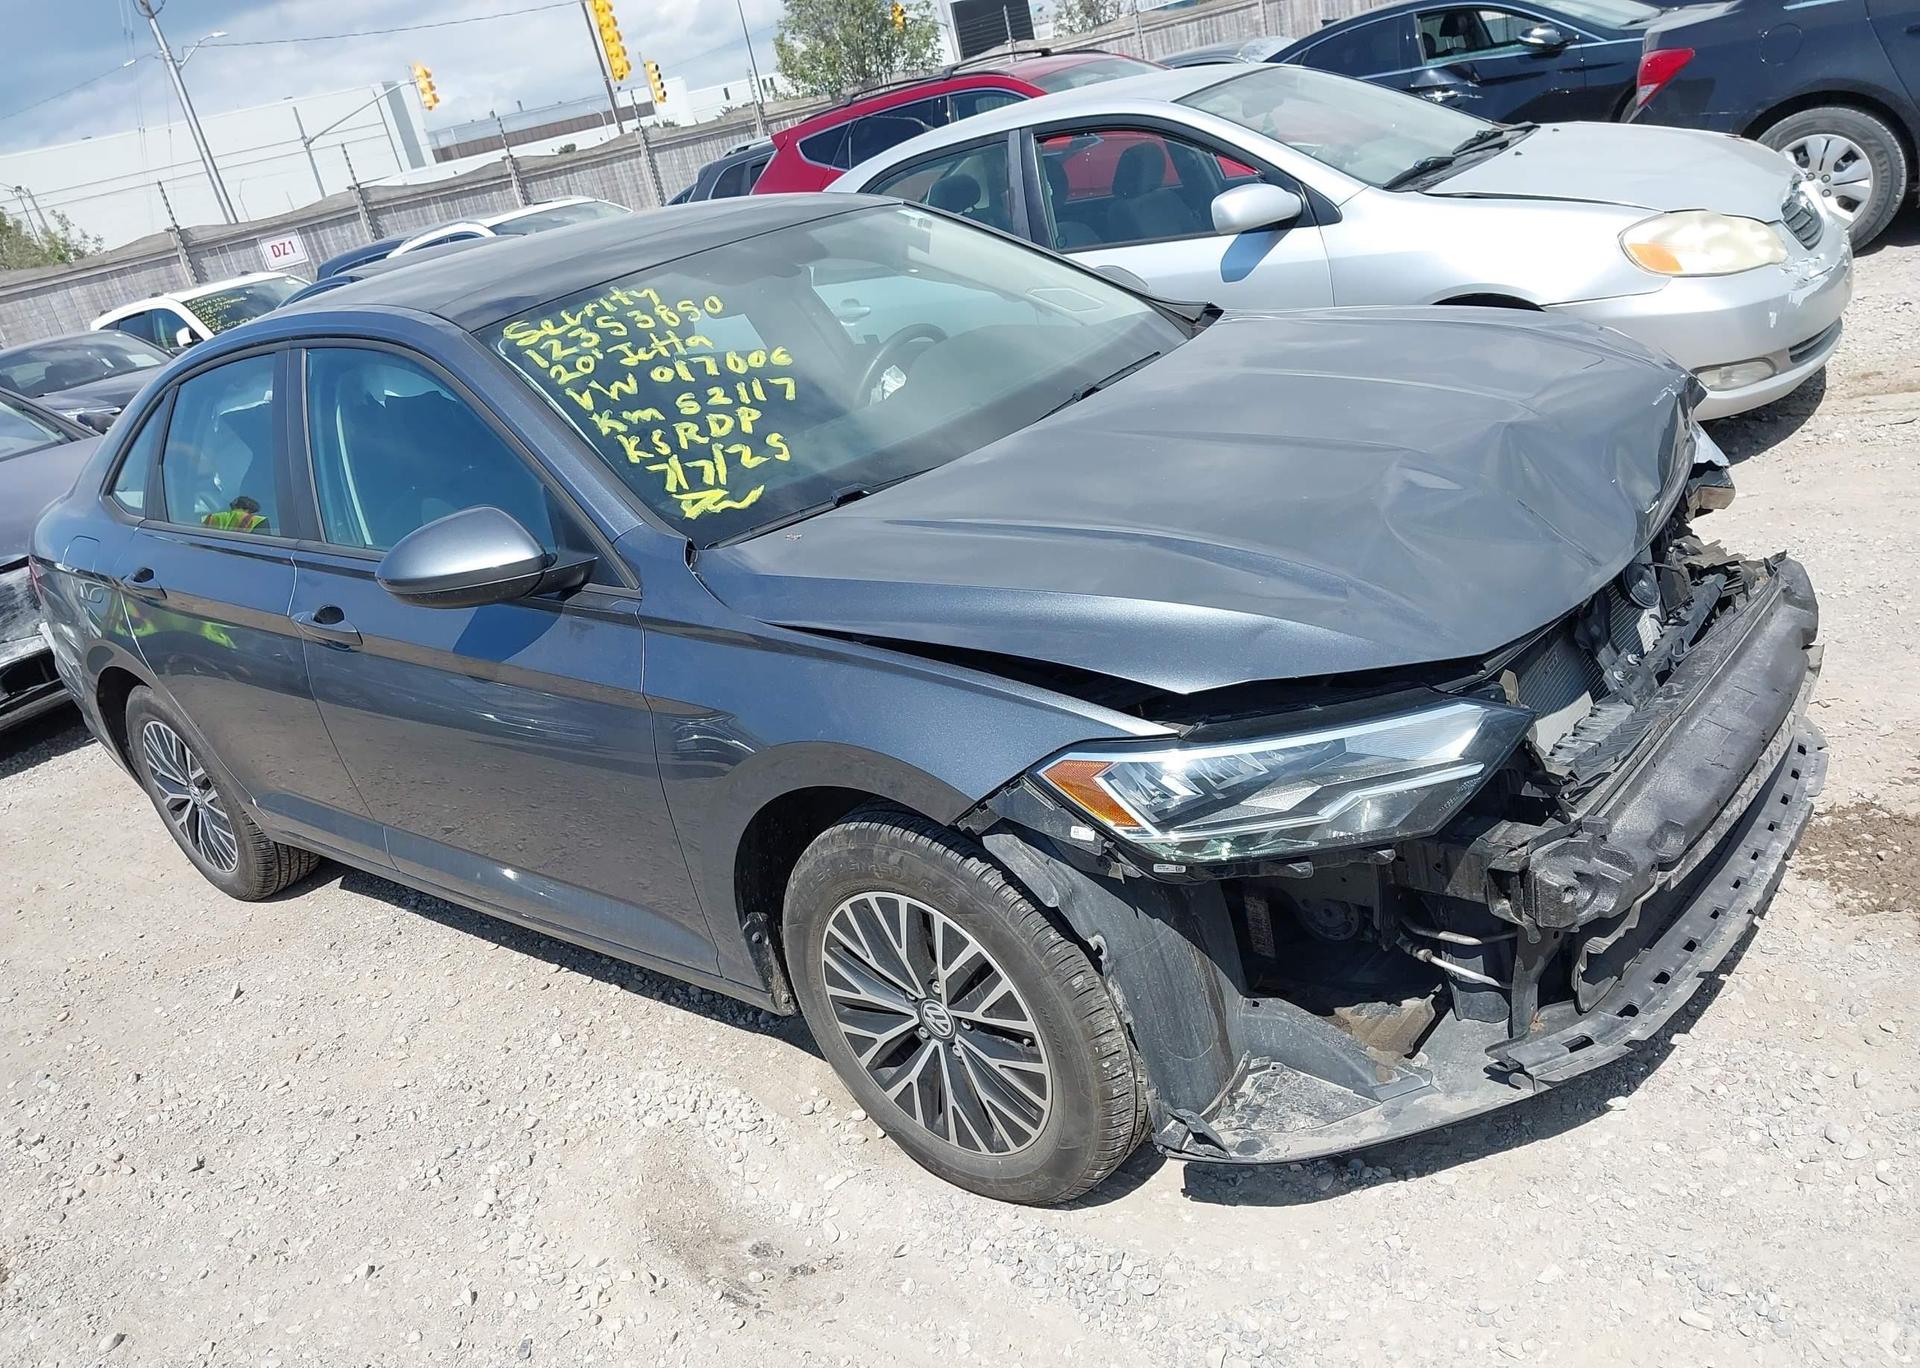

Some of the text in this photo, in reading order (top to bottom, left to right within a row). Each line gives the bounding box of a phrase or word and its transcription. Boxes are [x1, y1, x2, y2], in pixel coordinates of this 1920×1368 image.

[270, 240, 297, 258] DZ1
[522, 295, 724, 369] 12353850
[606, 329, 715, 366] Jetta
[564, 346, 793, 412] VW 017006
[675, 376, 797, 415] 52117
